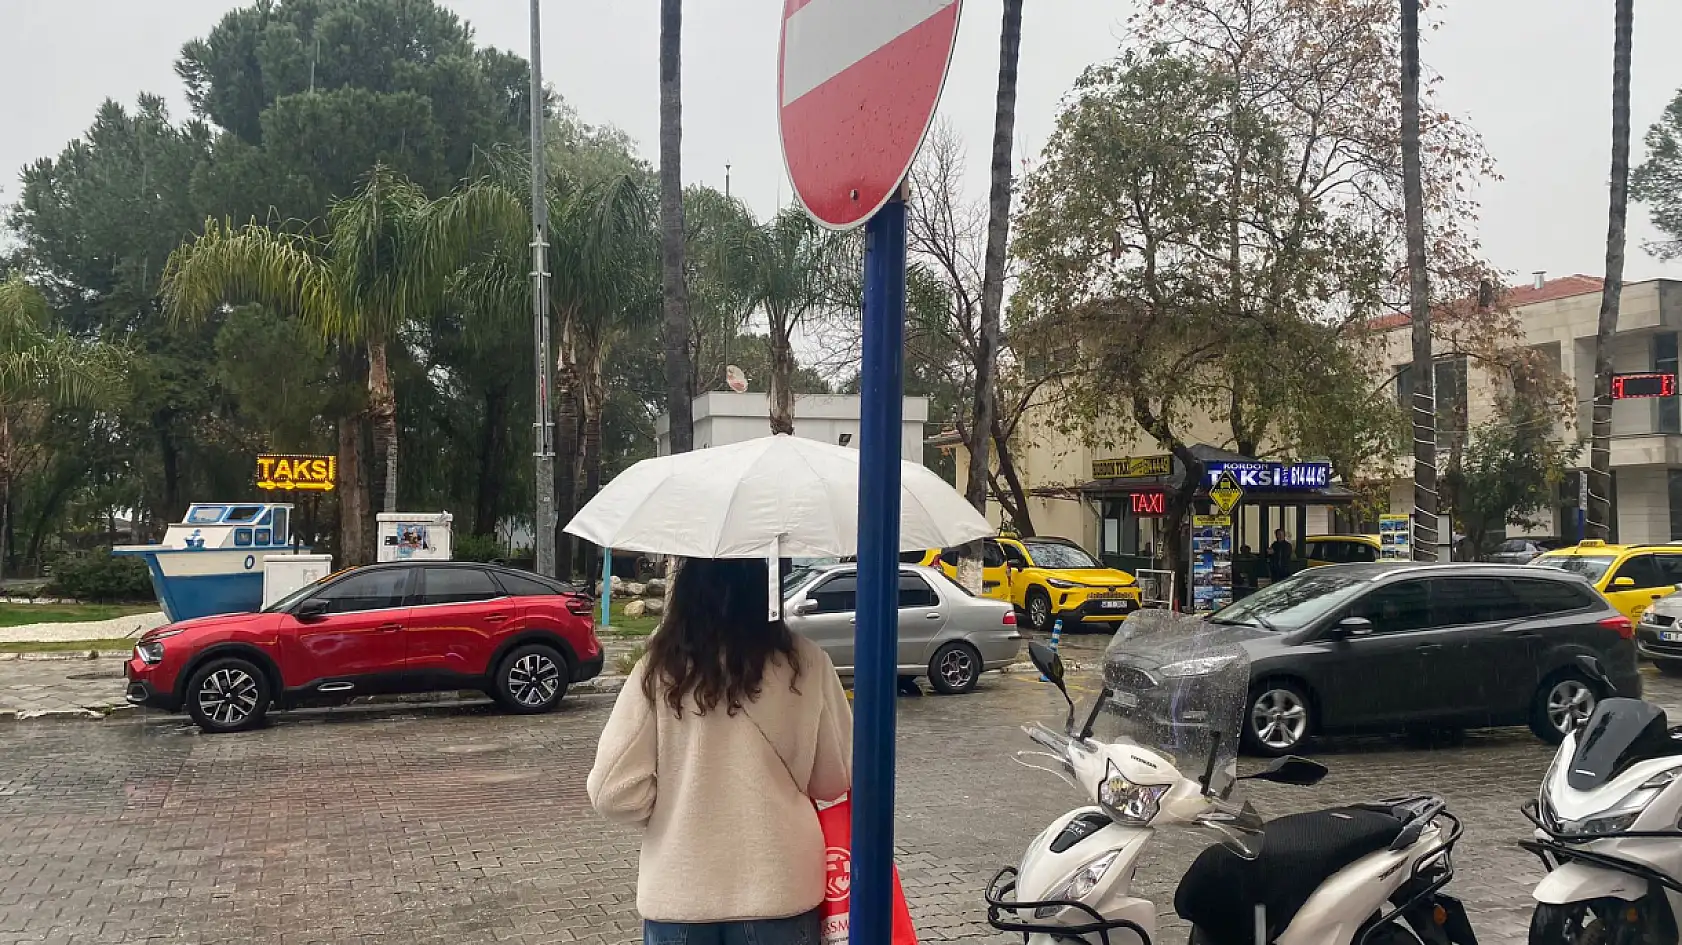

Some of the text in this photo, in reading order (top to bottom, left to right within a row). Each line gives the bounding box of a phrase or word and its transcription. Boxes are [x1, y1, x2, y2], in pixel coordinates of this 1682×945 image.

[1224, 462, 1269, 470] KORDON
[1291, 466, 1305, 486] 614
[1129, 493, 1164, 513] TAXI
